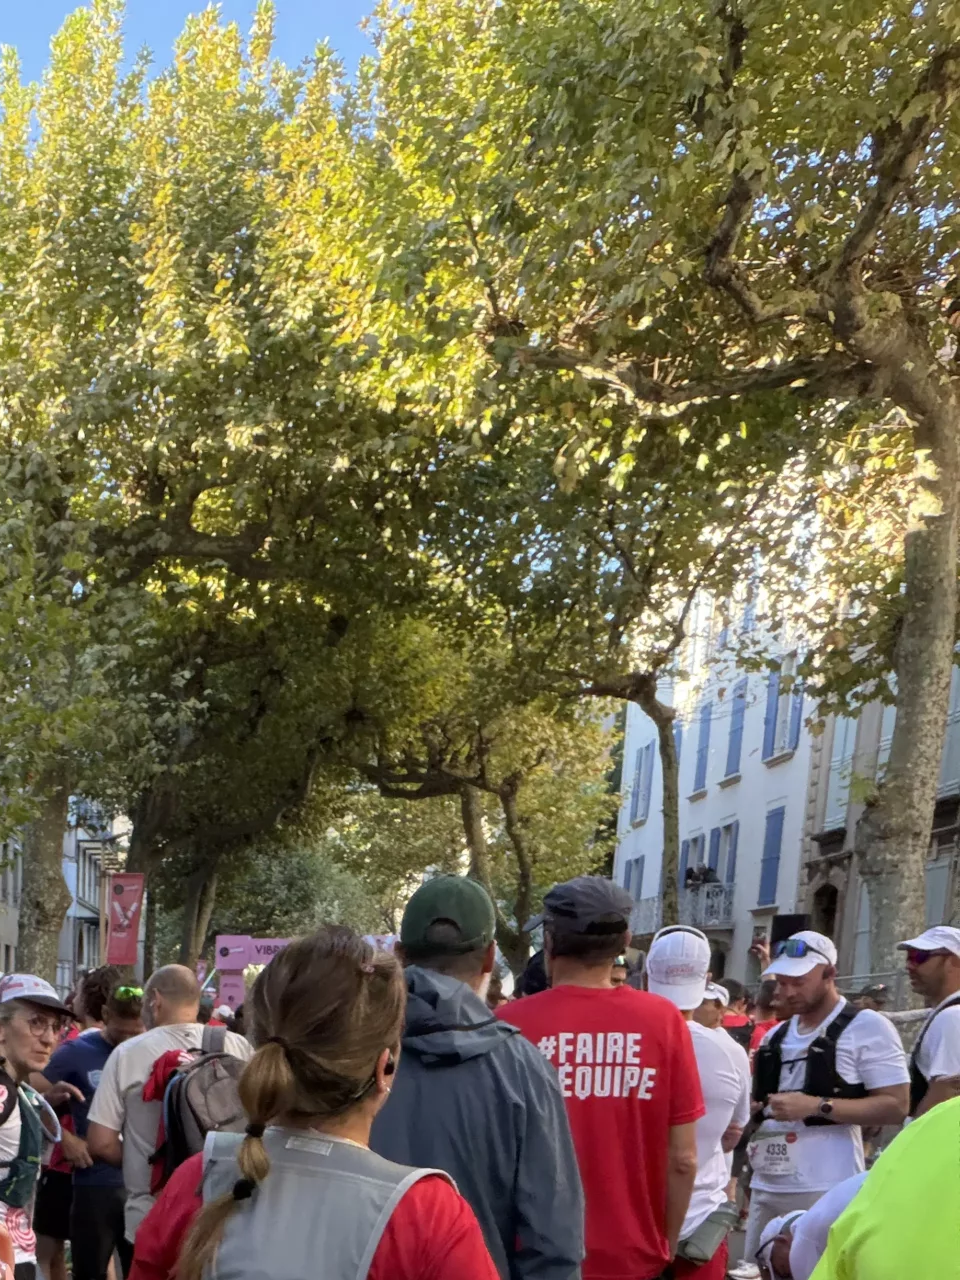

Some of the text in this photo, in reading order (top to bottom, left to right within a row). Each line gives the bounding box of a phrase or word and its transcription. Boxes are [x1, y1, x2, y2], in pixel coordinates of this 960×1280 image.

[537, 1032, 642, 1065] #FAIRE
[558, 1062, 657, 1101] ÉQUIPE
[766, 1143, 788, 1156] 4338
